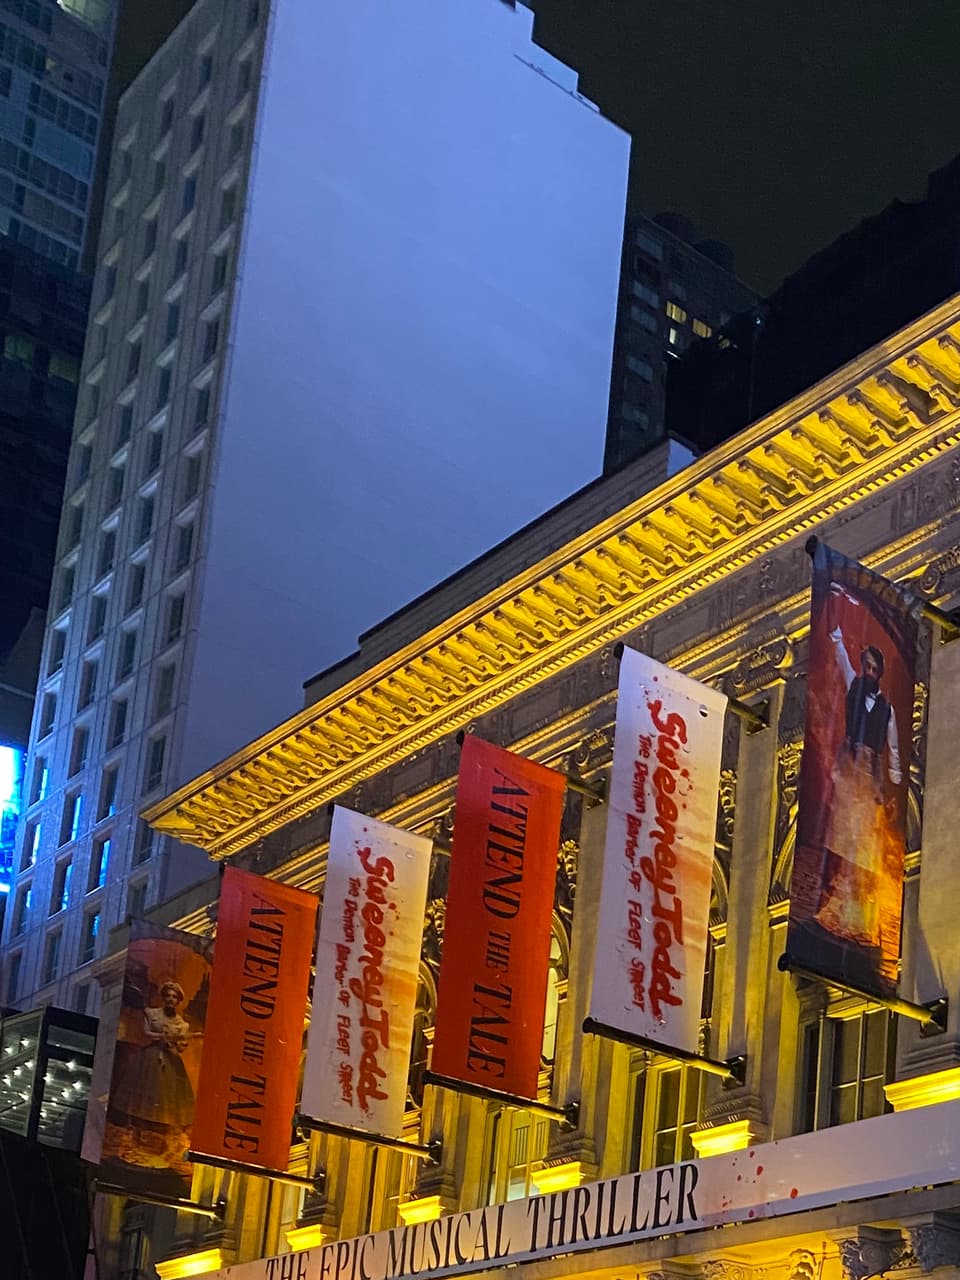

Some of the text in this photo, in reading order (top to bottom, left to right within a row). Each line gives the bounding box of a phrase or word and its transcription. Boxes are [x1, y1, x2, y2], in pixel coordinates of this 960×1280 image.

[349, 847, 395, 1112] Sweeney Todd
[466, 767, 531, 1078] ATTEND THE TALE
[640, 700, 687, 1019] Sweeney Todd
[223, 893, 286, 1154] ATTEND THE TALE
[384, 1204, 511, 1280] MUSICAL
[527, 1163, 699, 1253] THRILLER
